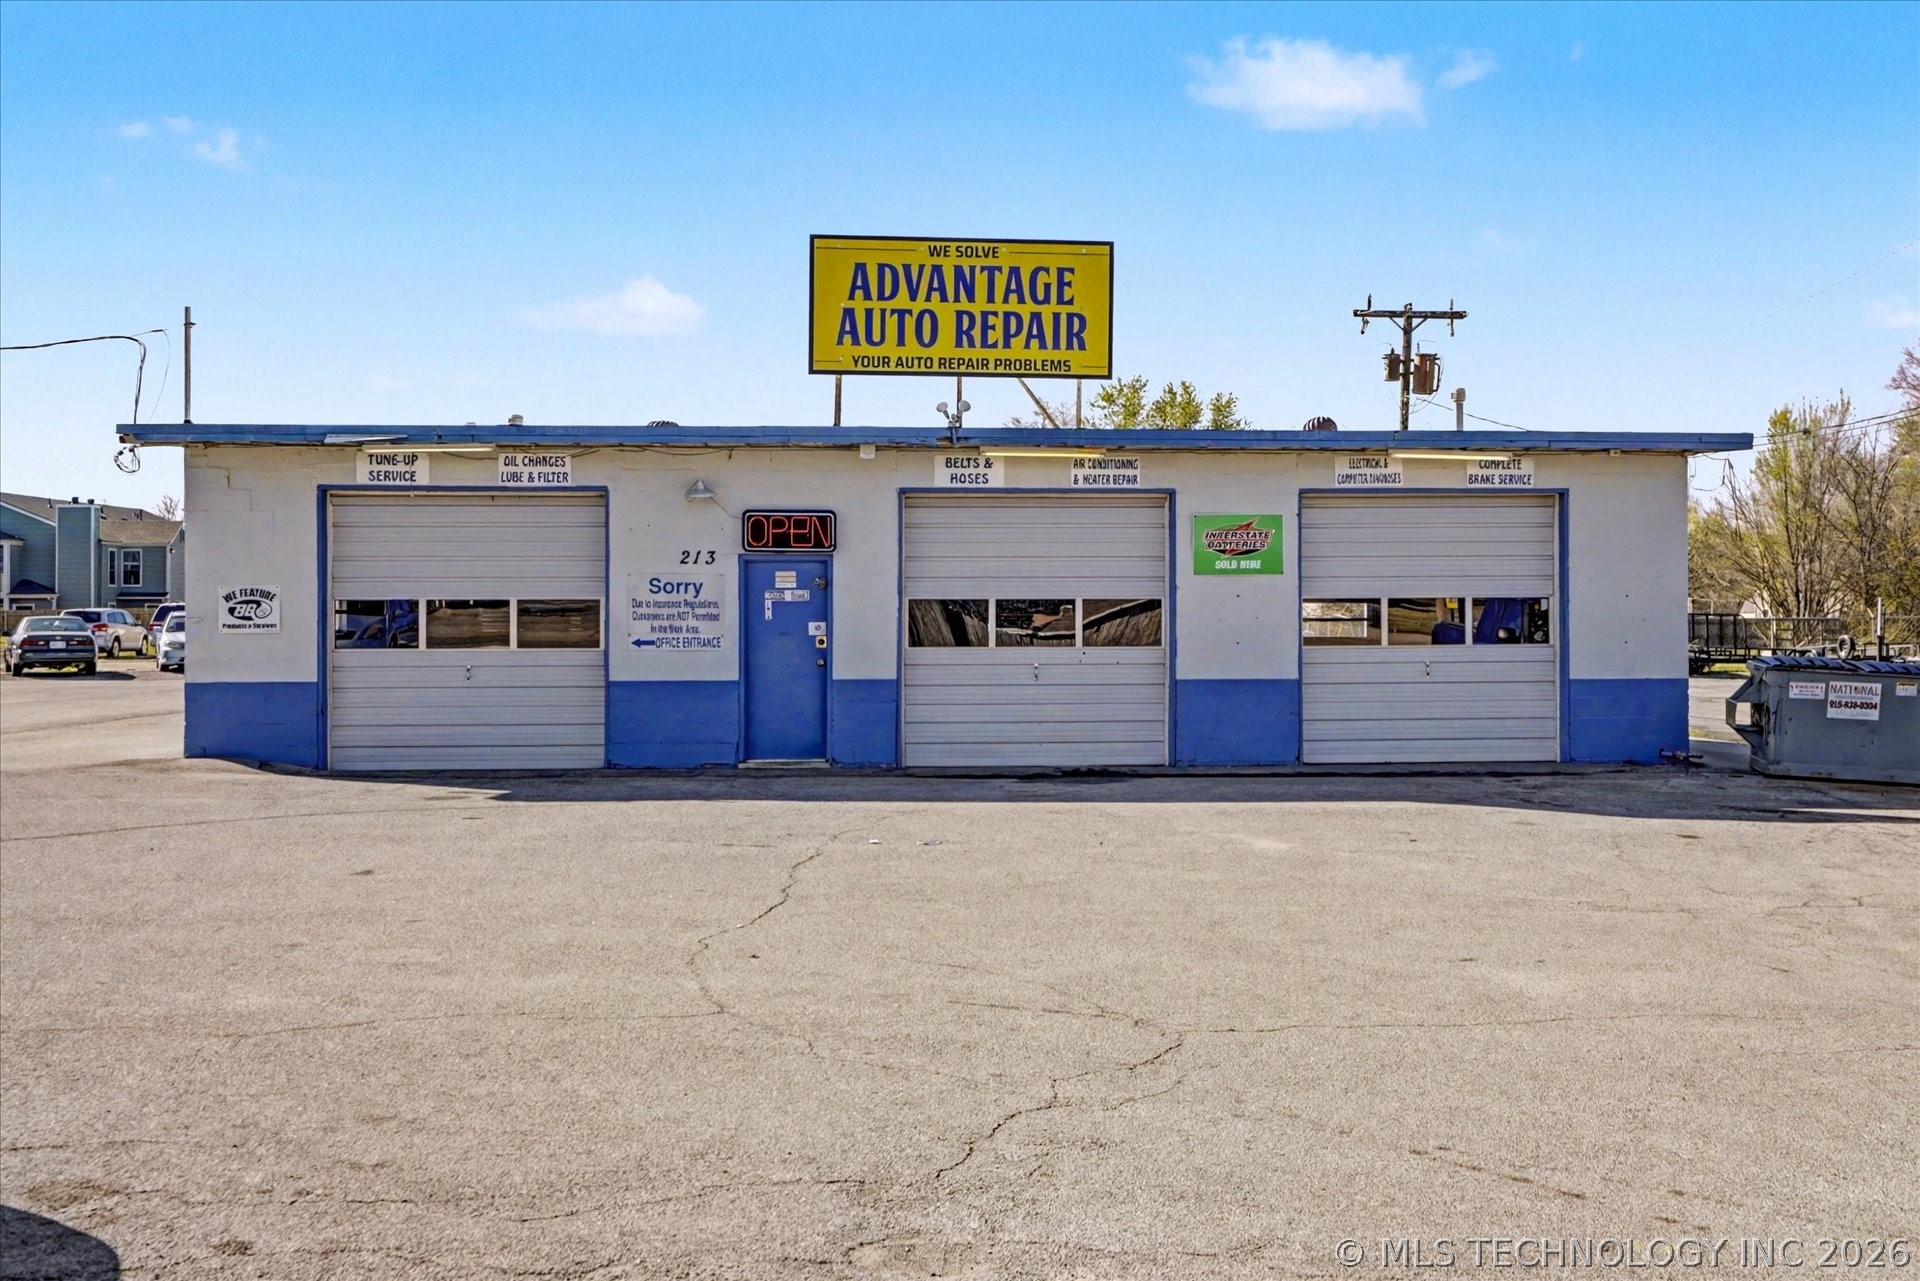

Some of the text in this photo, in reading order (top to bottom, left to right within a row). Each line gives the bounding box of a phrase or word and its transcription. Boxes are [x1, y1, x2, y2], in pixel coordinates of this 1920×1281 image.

[928, 244, 1000, 259] WE SOLVE
[847, 262, 1075, 306] ADVANTAGE
[835, 307, 1087, 351] AUTO REPAIR
[852, 355, 1071, 372] YOUR AUTO REPAIR PROBLEMS
[368, 454, 418, 467] TUNE-UP
[503, 455, 566, 468] OIL CHANGES
[945, 457, 994, 469] BELTS &
[1073, 458, 1139, 470] AIR CONDITIONING
[1479, 459, 1522, 470] COMPLETE
[368, 470, 417, 482] SERVICE
[501, 471, 569, 484] LUBE & FILTER
[950, 473, 990, 485] HOSES
[1073, 474, 1080, 485] &
[1468, 473, 1532, 485] BRAKE SERVICE
[748, 515, 831, 548] OPEN
[1205, 531, 1270, 539] INTERSTATE
[680, 550, 716, 565] 213
[1215, 560, 1237, 569] SOLD
[648, 577, 703, 599] Sorry
[222, 588, 277, 603] WE FEATURE
[655, 636, 722, 648] OFFICE ENTRANCE
